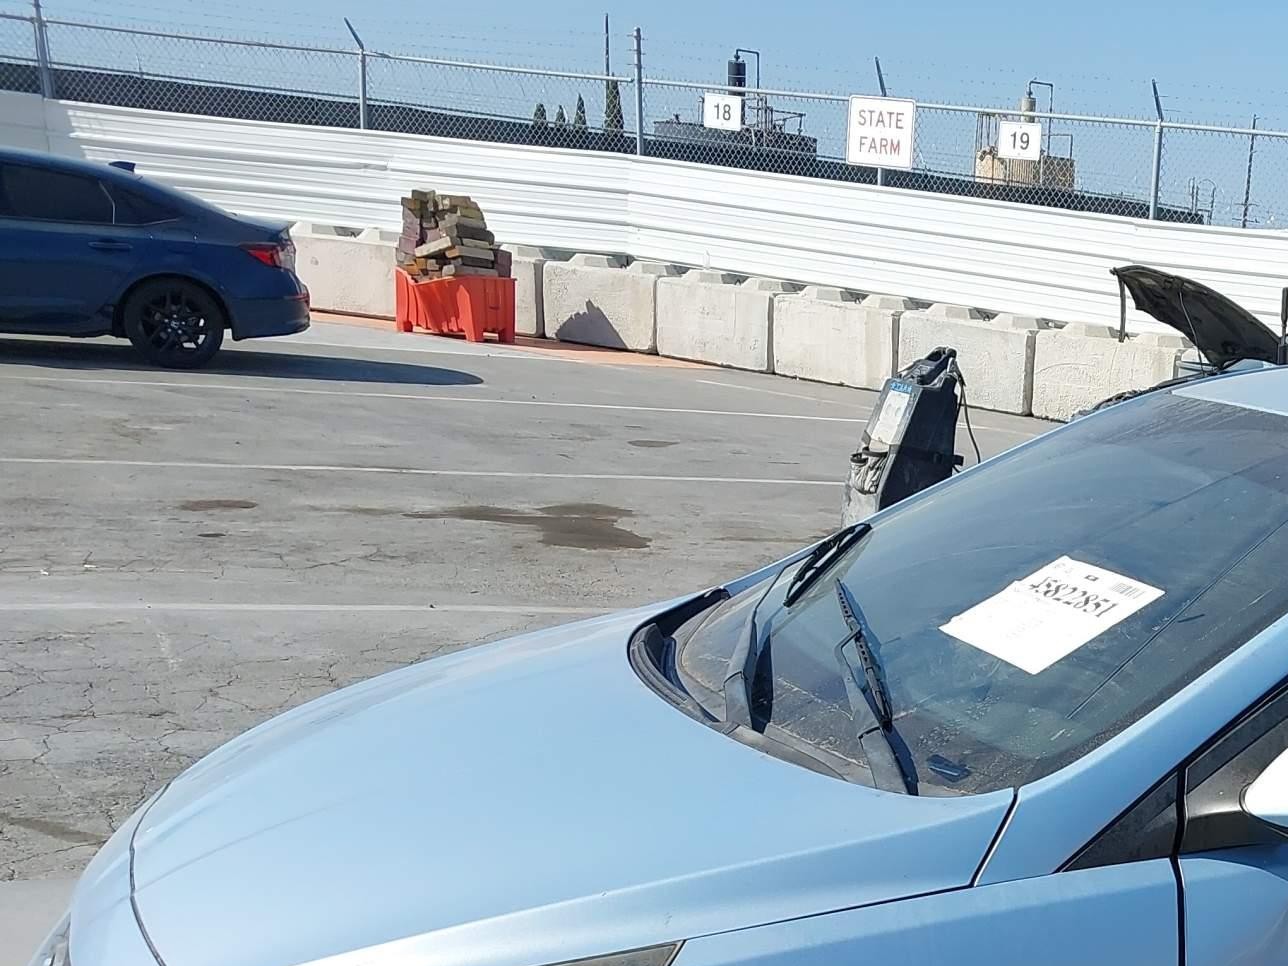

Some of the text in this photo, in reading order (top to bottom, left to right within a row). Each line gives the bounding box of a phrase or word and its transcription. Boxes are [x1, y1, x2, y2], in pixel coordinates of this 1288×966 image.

[714, 103, 731, 121] 18
[858, 109, 905, 130] STATE
[859, 136, 901, 156] FARM
[1010, 132, 1030, 150] 19
